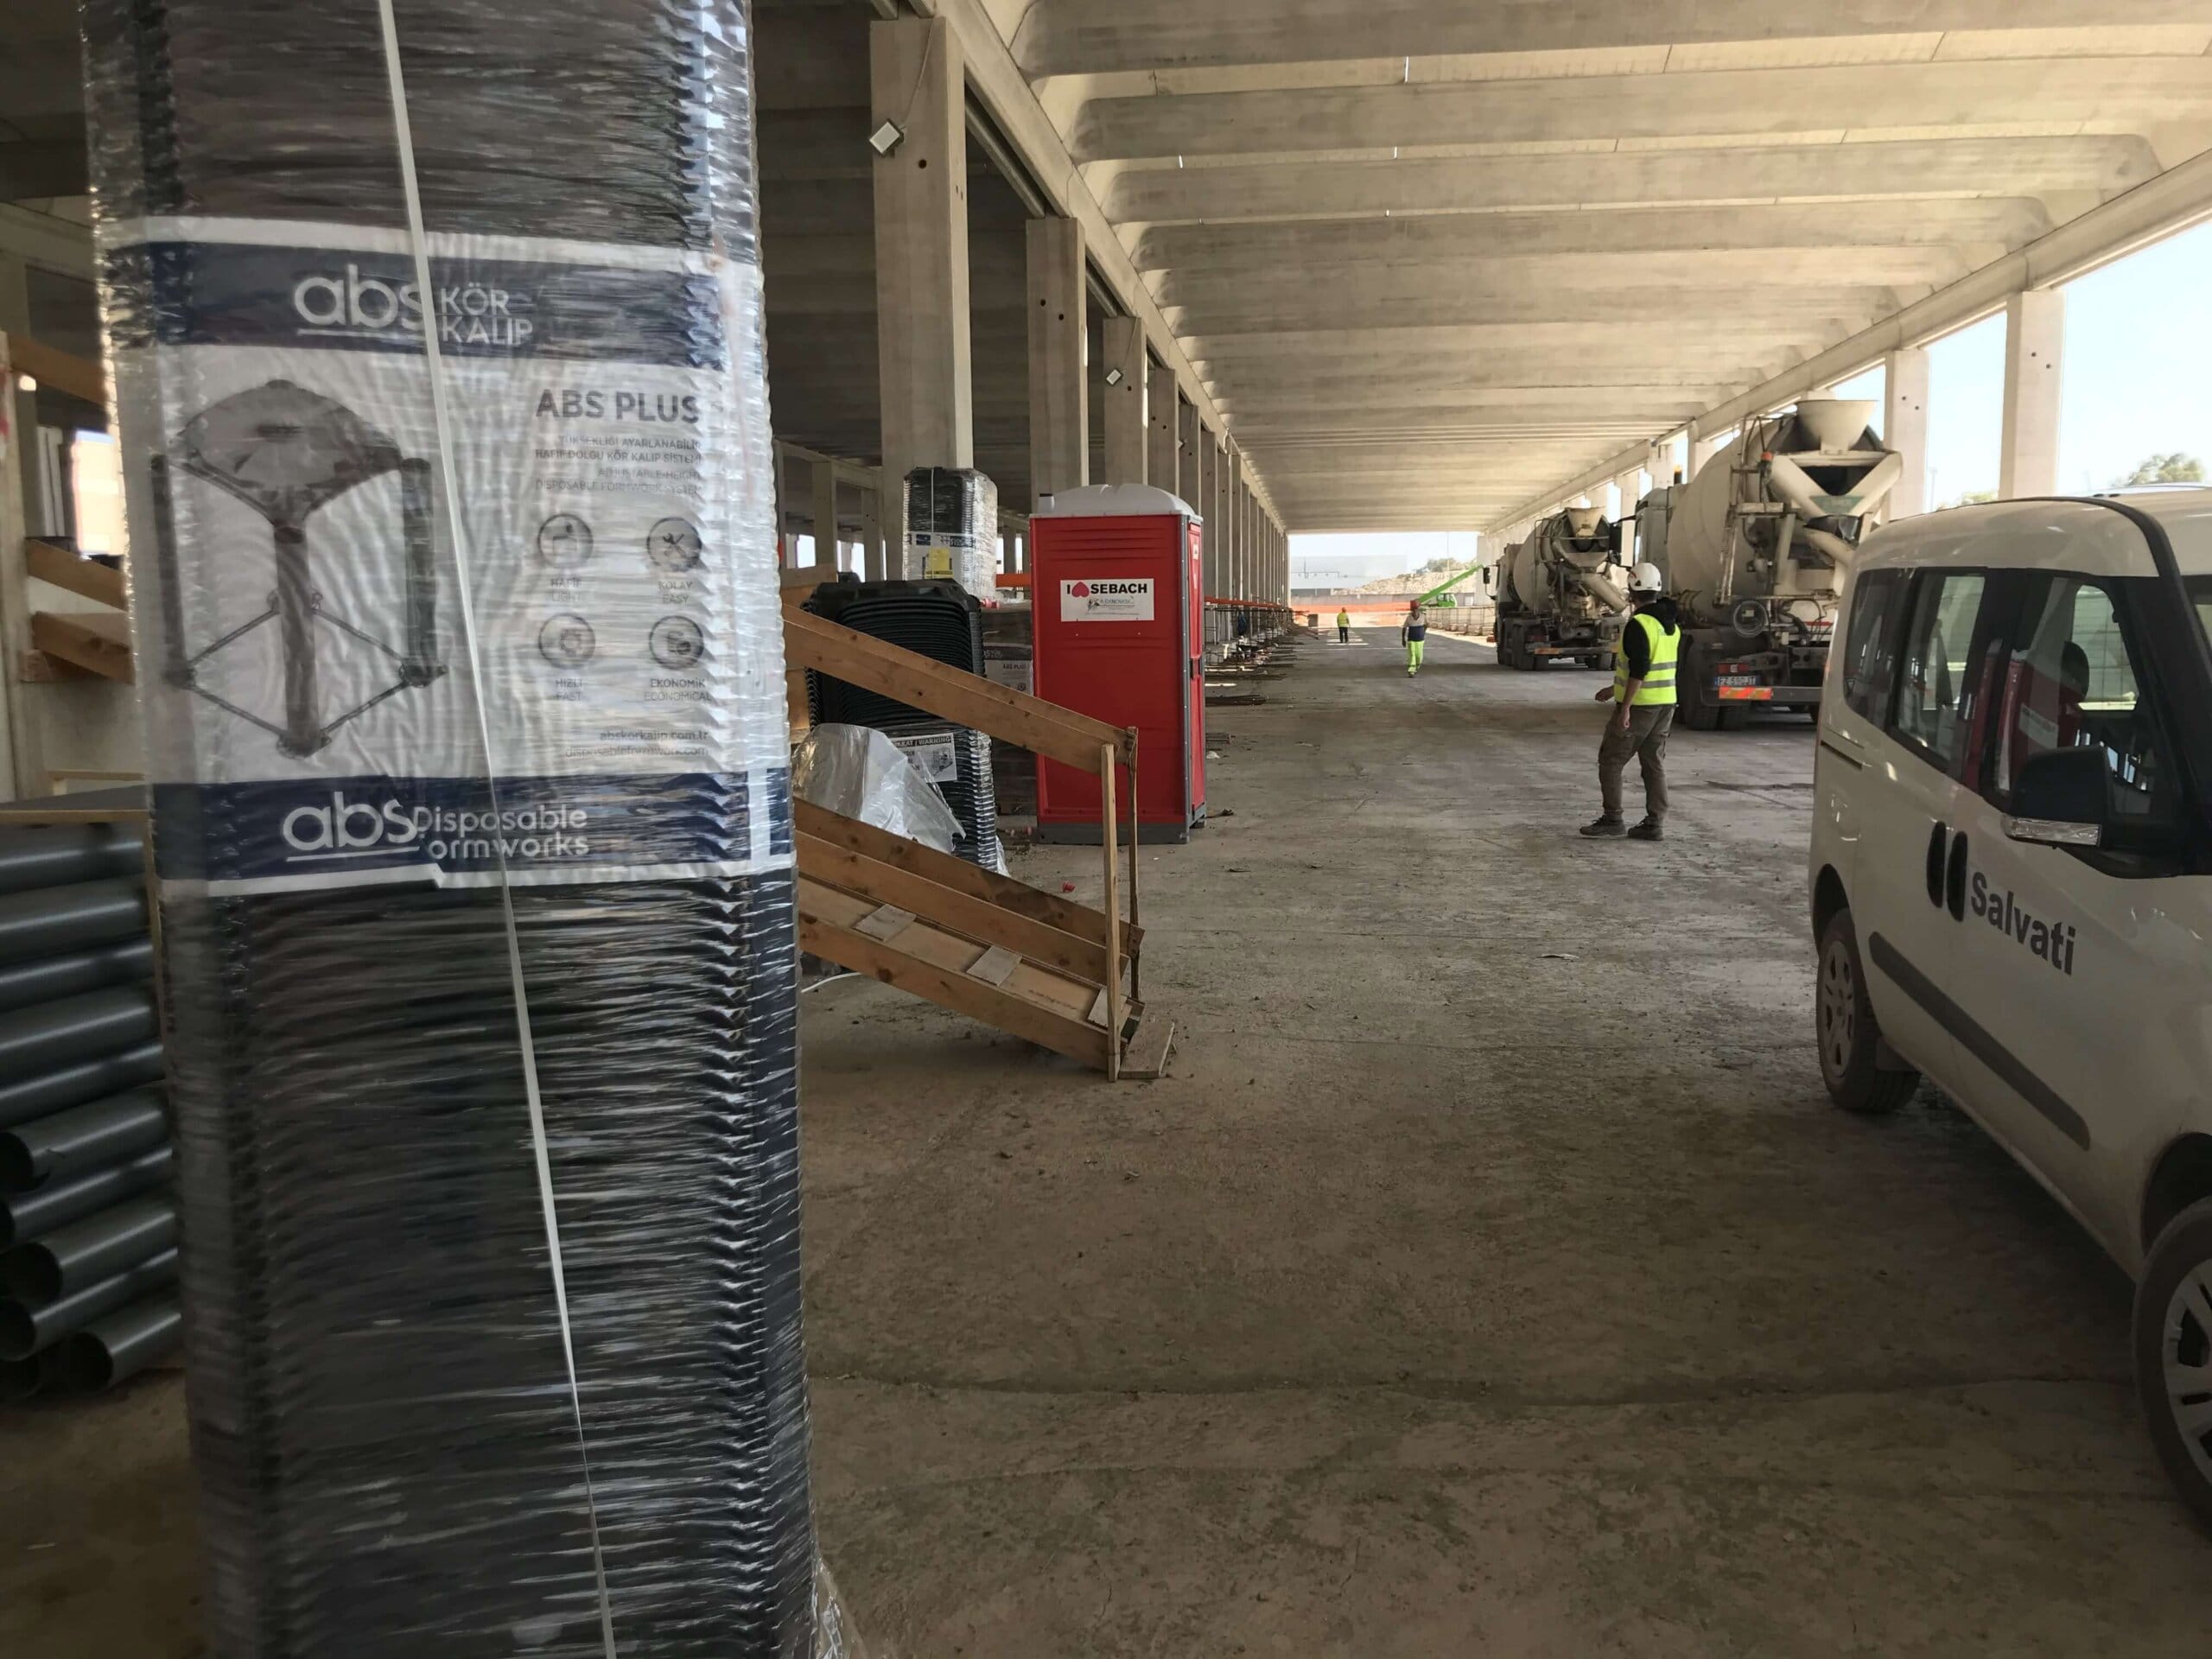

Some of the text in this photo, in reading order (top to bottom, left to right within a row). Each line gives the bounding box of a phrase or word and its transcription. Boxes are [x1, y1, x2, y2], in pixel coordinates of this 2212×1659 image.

[294, 263, 424, 330] abs
[441, 283, 510, 315] KÖR
[442, 316, 532, 345] KALIP
[536, 389, 699, 423] ABS PLUS
[607, 450, 629, 461] KÖR
[631, 452, 661, 462] KALIP
[1090, 583, 1147, 594] SEBACH
[918, 736, 951, 746] WARNING
[283, 791, 417, 851] abs
[412, 804, 588, 837] Disposable
[426, 831, 590, 860] ormworks
[1971, 871, 2076, 976] Salvati
